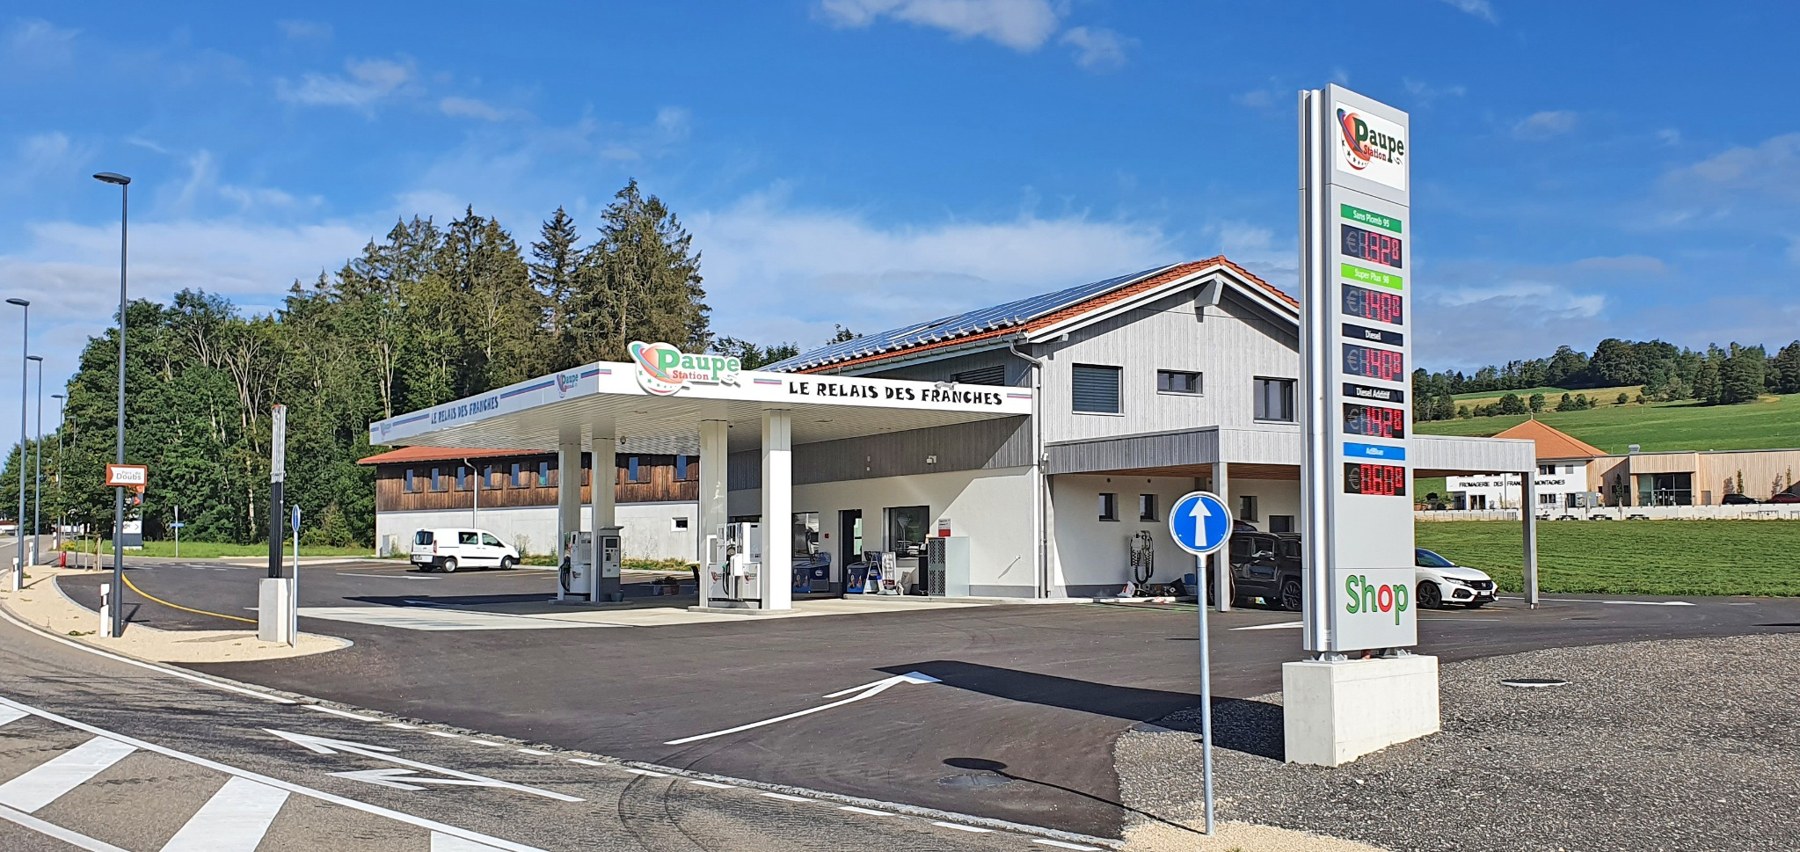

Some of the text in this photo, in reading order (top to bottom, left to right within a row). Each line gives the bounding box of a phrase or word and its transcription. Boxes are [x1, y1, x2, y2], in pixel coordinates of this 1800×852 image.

[1352, 117, 1404, 163] Paupe
[1363, 145, 1387, 161] Station
[1353, 210, 1390, 228] Sans Plomb 95
[1355, 268, 1370, 280] Super
[1370, 272, 1382, 282] Plus
[1365, 329, 1381, 340] Diesel
[655, 349, 740, 381] Paupe
[673, 370, 709, 381] Station
[789, 382, 1003, 405] LE RELAIS DES FRANCHES
[1356, 387, 1373, 397] Diesel
[431, 396, 499, 424] LE RELAIS DES FRANCHES
[116, 473, 142, 481] Doubs
[1345, 574, 1409, 626] Shop
